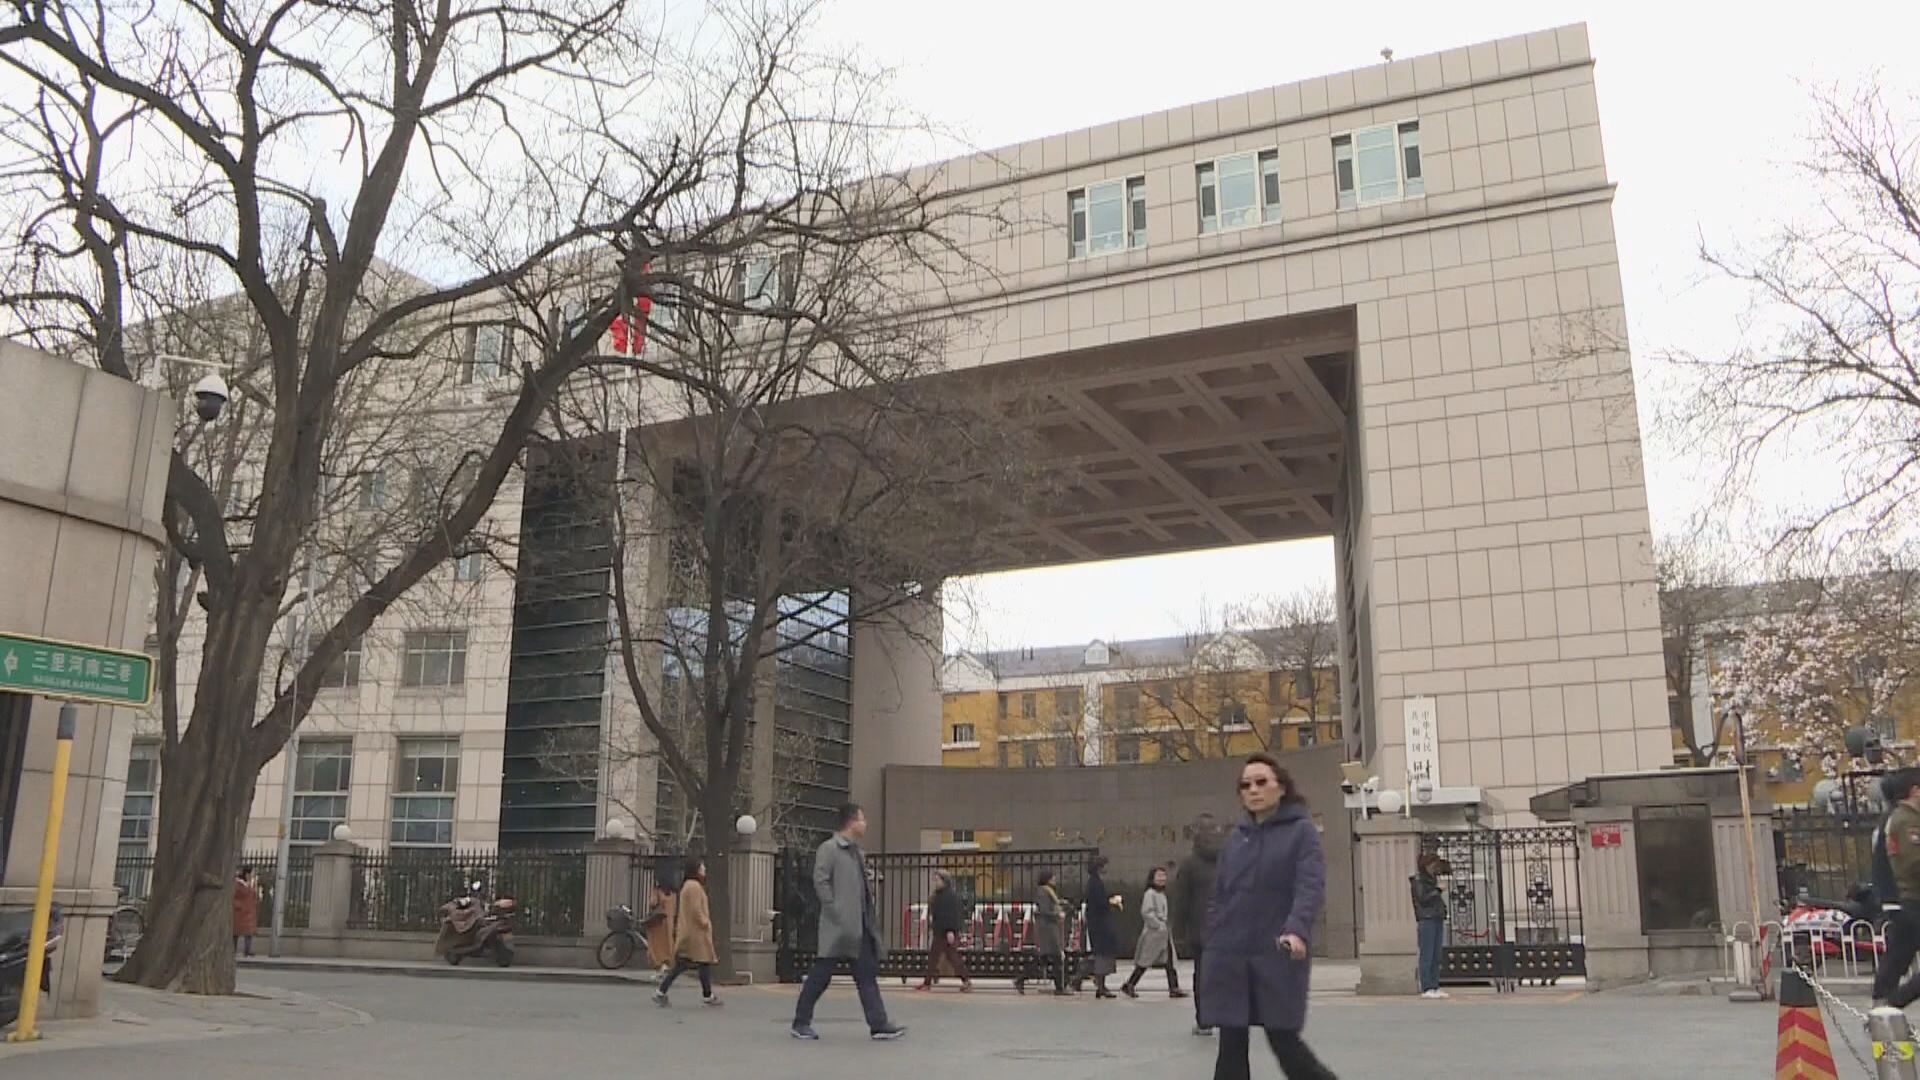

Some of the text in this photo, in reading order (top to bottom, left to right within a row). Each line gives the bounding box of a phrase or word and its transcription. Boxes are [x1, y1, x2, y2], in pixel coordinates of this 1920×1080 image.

[32, 650, 132, 682] 三里河南三巷
